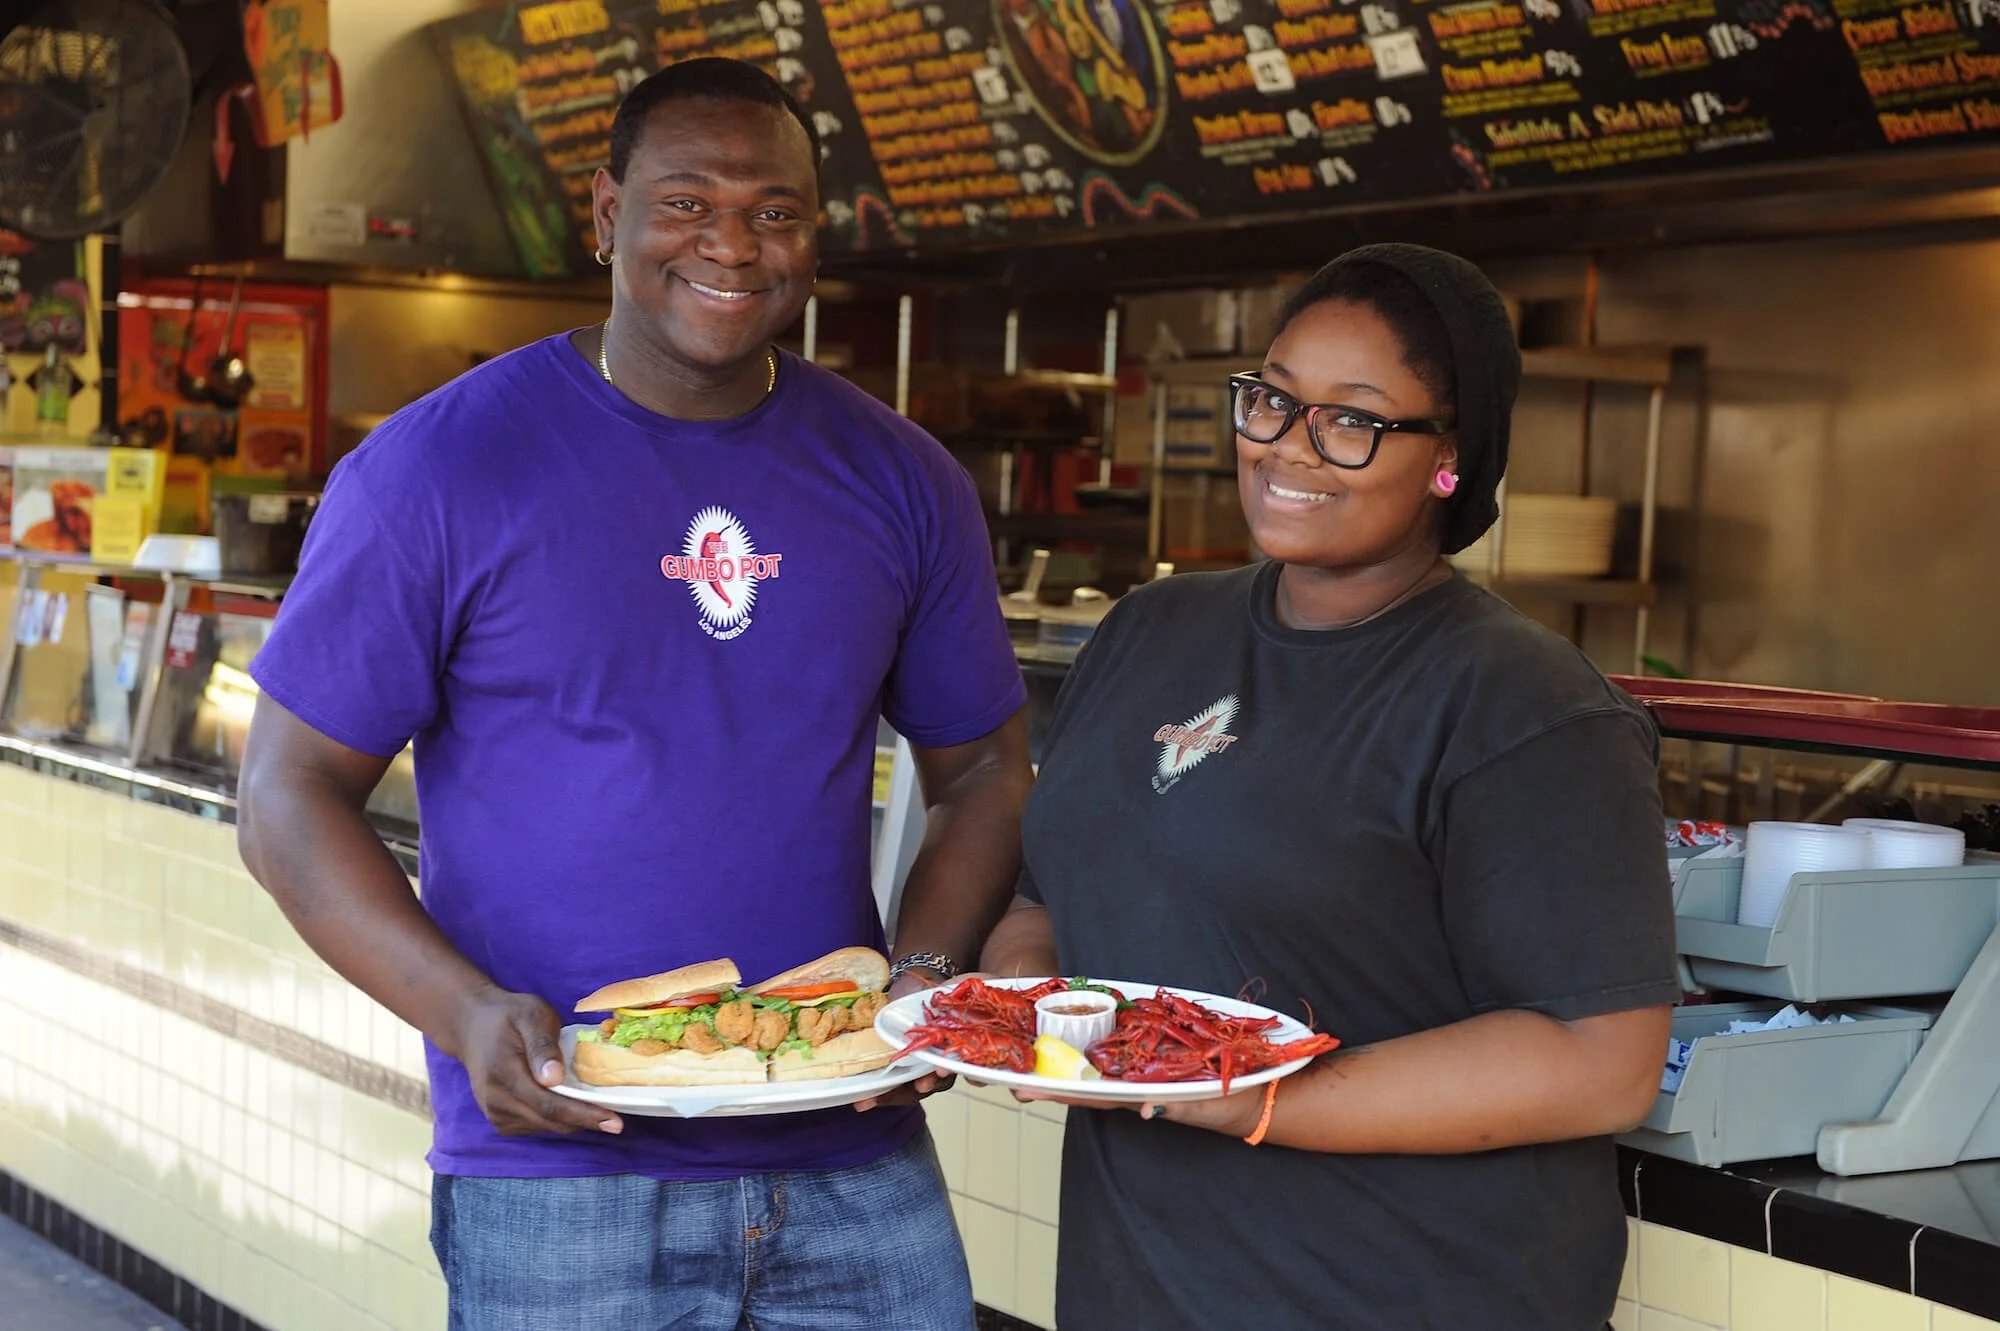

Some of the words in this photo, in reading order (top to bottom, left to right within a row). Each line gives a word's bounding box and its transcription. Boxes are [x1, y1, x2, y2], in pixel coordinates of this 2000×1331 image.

[661, 555, 735, 582] GUMBO
[738, 553, 782, 580] POT
[698, 618, 714, 635] LOS
[713, 616, 752, 641] ANGELES
